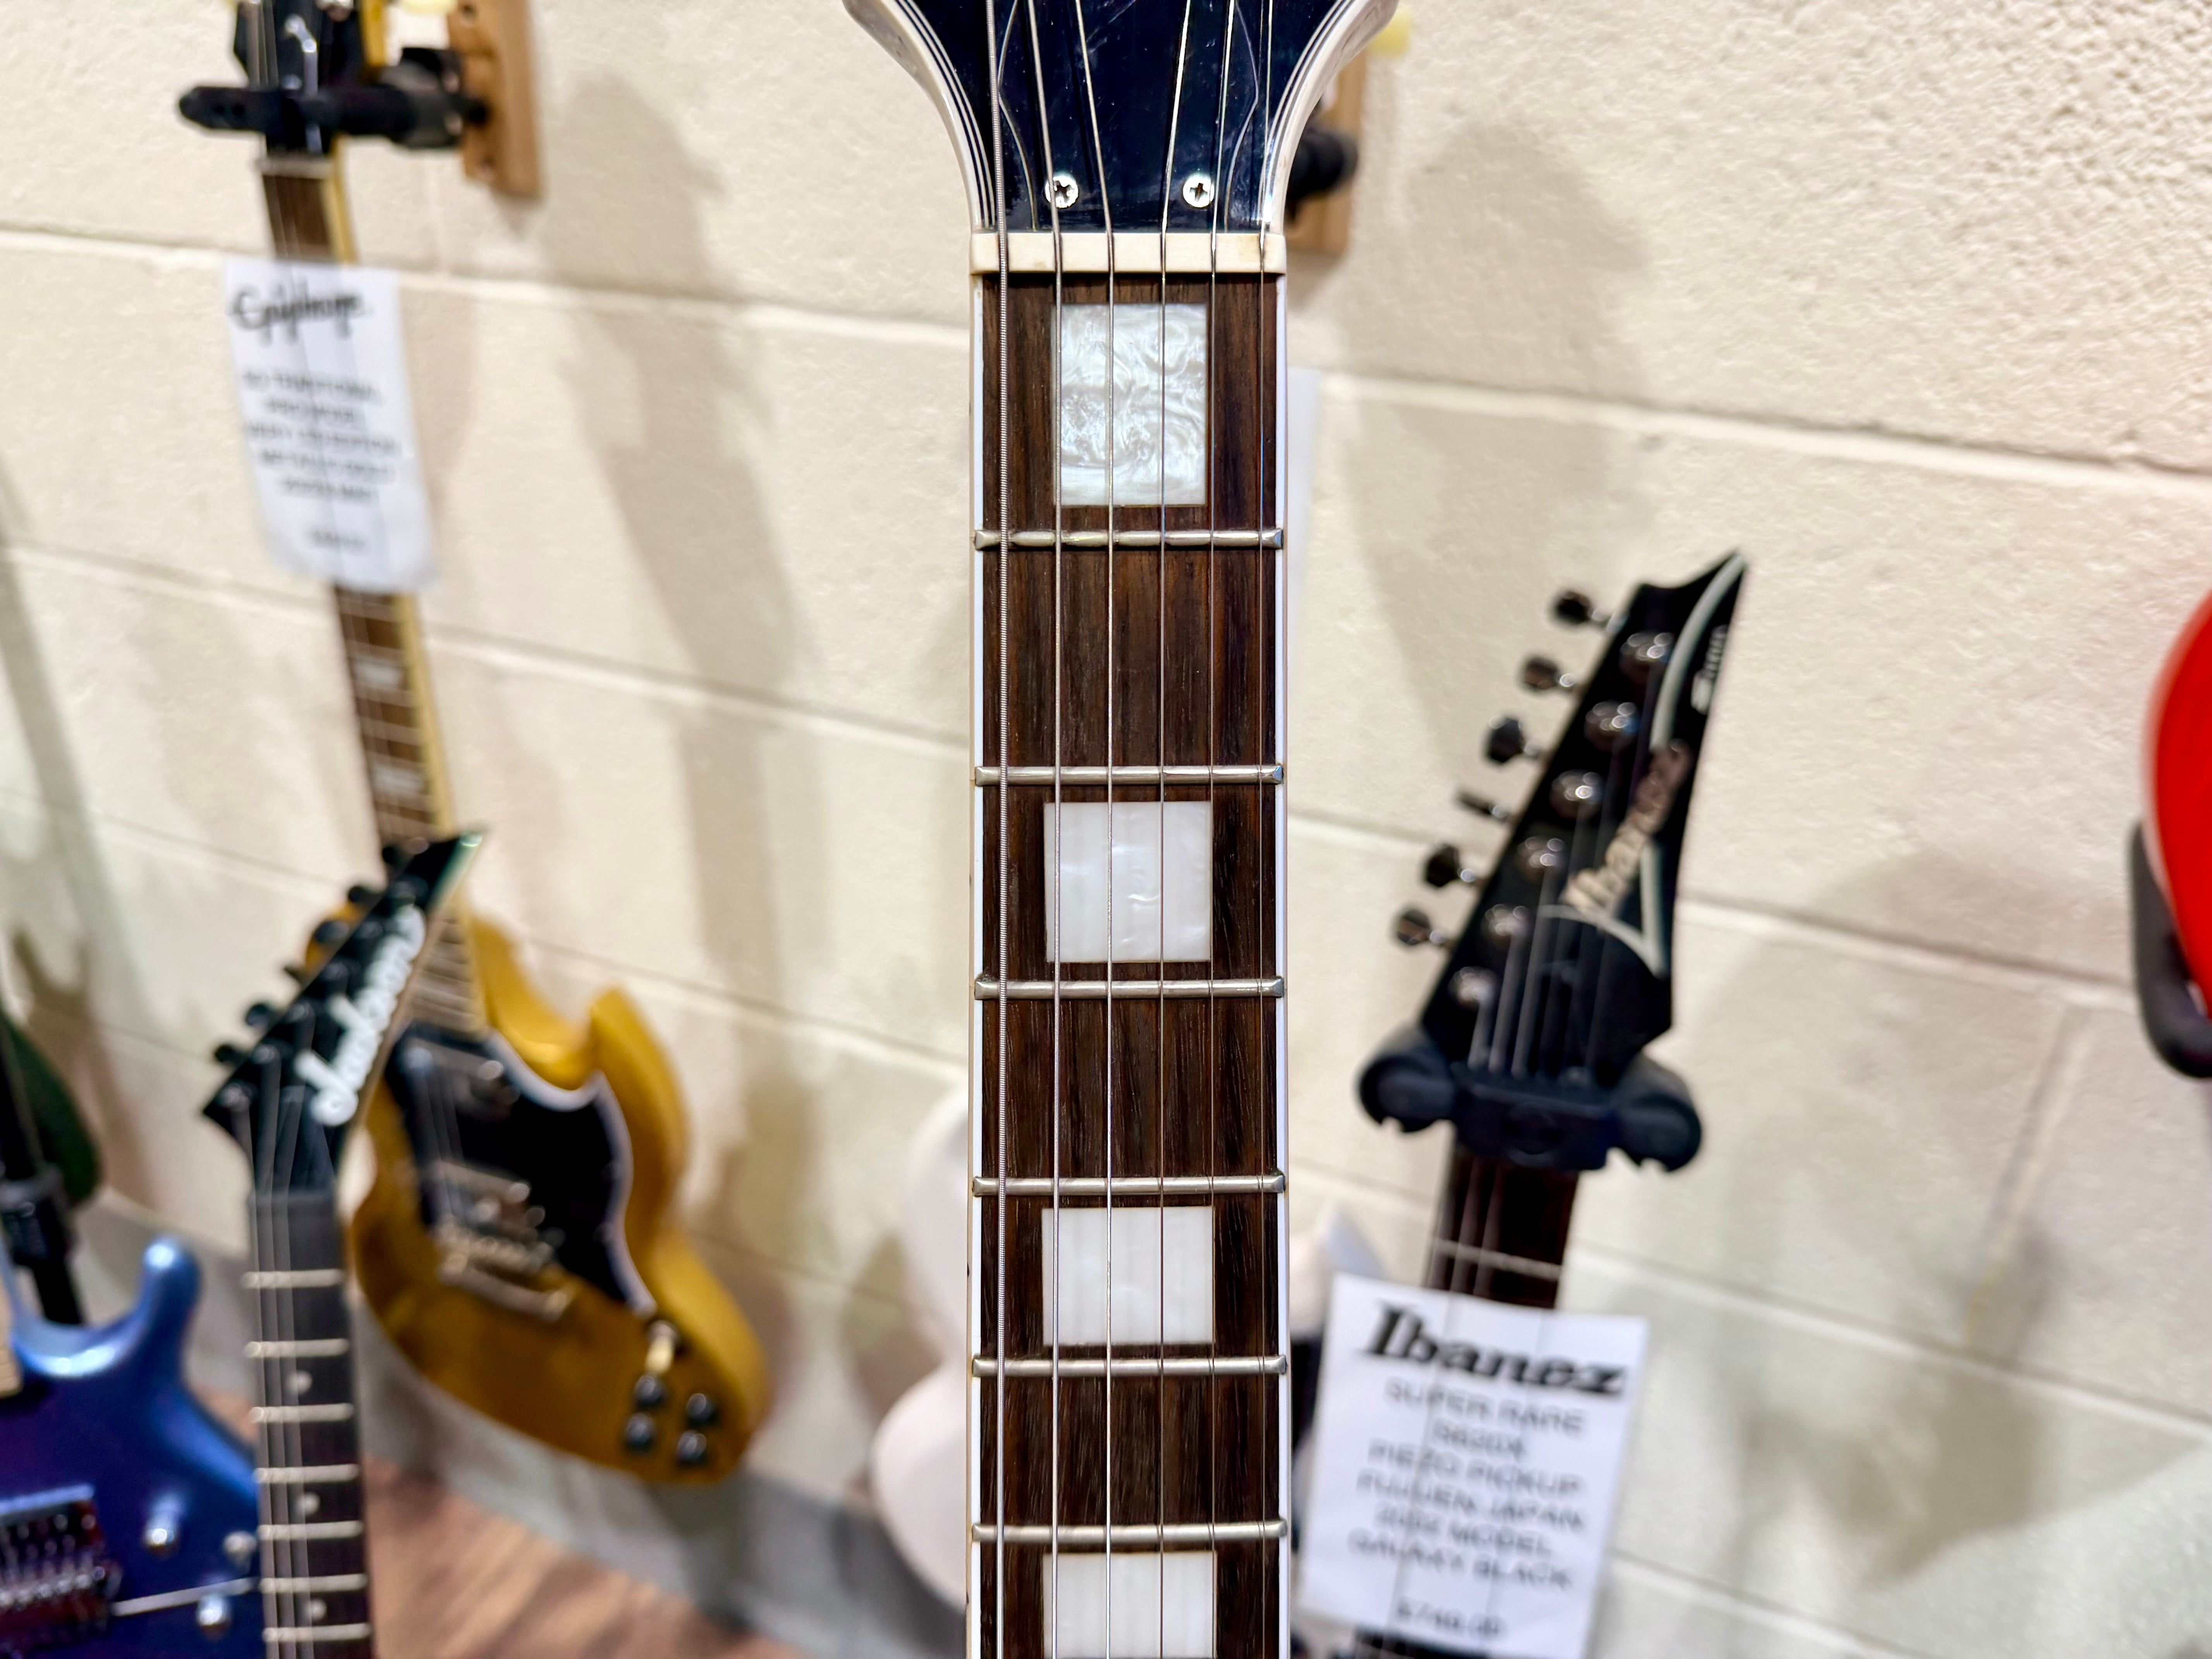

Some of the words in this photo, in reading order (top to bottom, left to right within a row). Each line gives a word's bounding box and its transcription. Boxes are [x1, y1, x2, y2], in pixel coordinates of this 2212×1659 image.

[1360, 1299, 1625, 1395] Ibanez
[1384, 1381, 1494, 1424] SUPER
[1498, 1401, 1588, 1442] RARE
[1368, 1441, 1462, 1480] PIEZO
[1467, 1459, 1583, 1501] PICKUP
[1448, 1518, 1556, 1561] MODEL
[1484, 1495, 1584, 1535] JAPAN
[1473, 1553, 1575, 1594] BLACK
